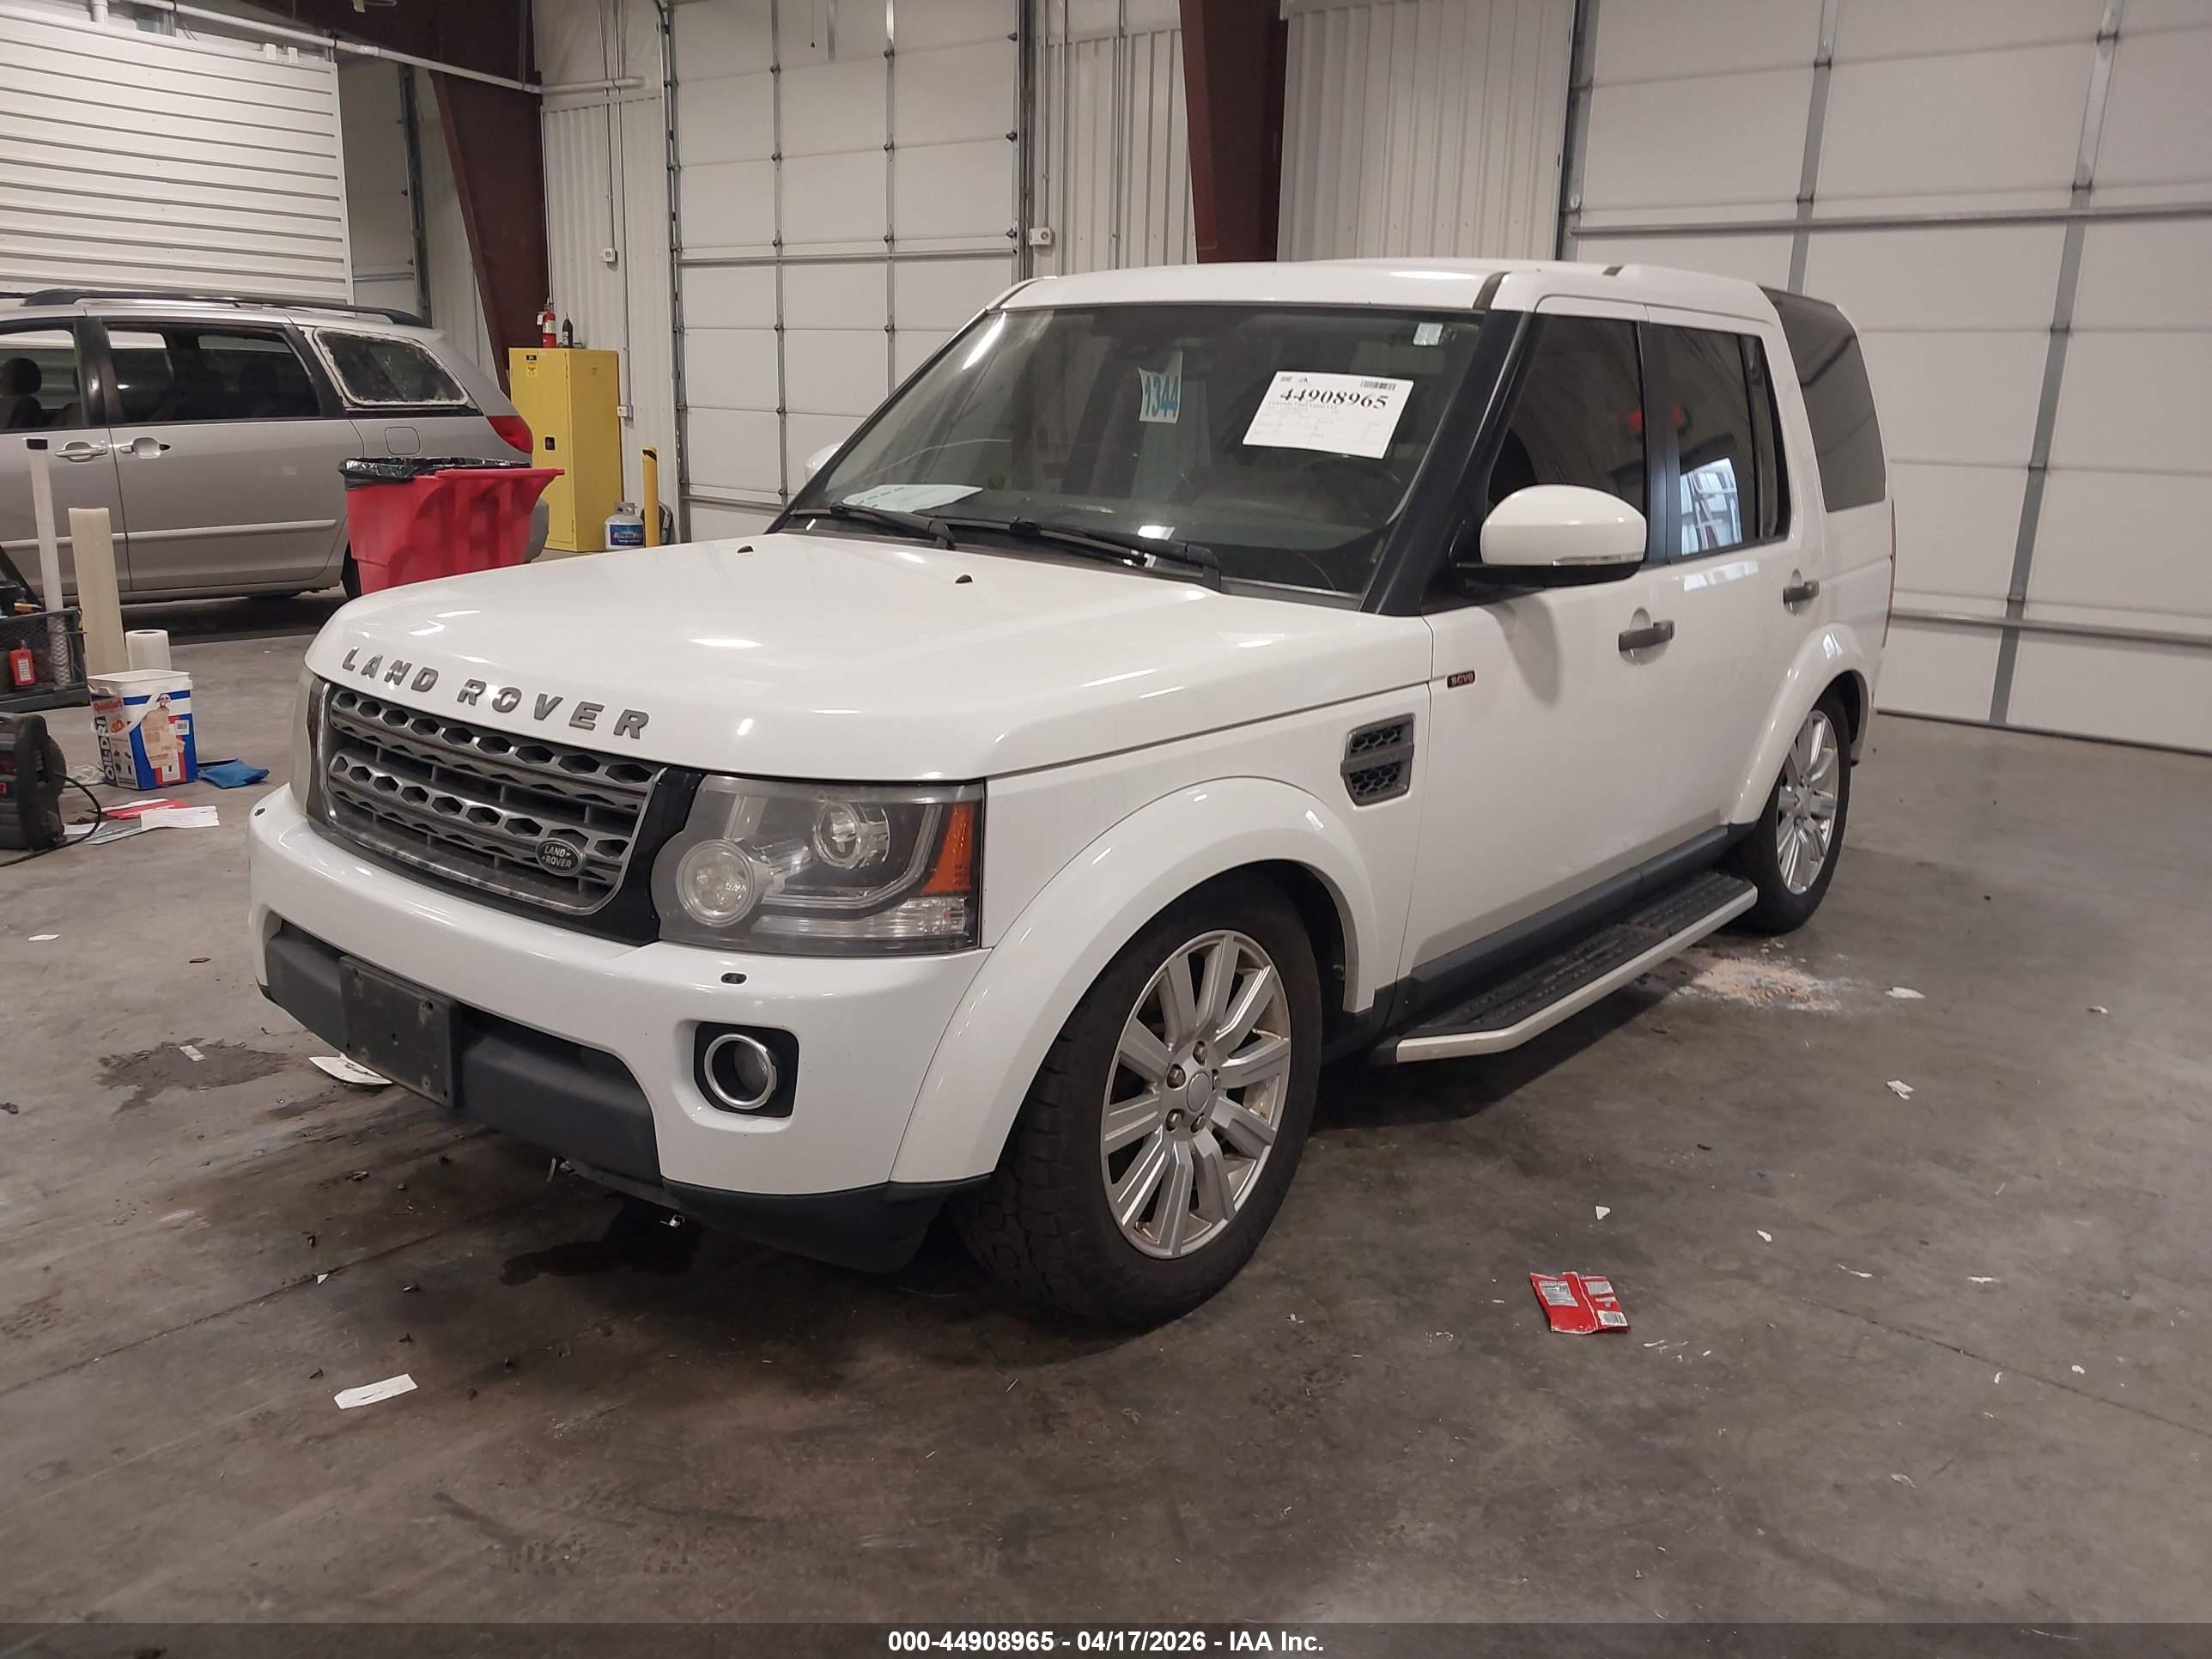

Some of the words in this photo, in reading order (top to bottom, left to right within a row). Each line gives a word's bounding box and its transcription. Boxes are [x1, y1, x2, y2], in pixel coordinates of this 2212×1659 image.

[1144, 374, 1179, 419] 1344
[1279, 386, 1389, 410] 44908965
[342, 646, 439, 693] LAND
[456, 678, 650, 739] ROVER
[544, 844, 567, 858] LAND
[545, 855, 573, 869] ROVER
